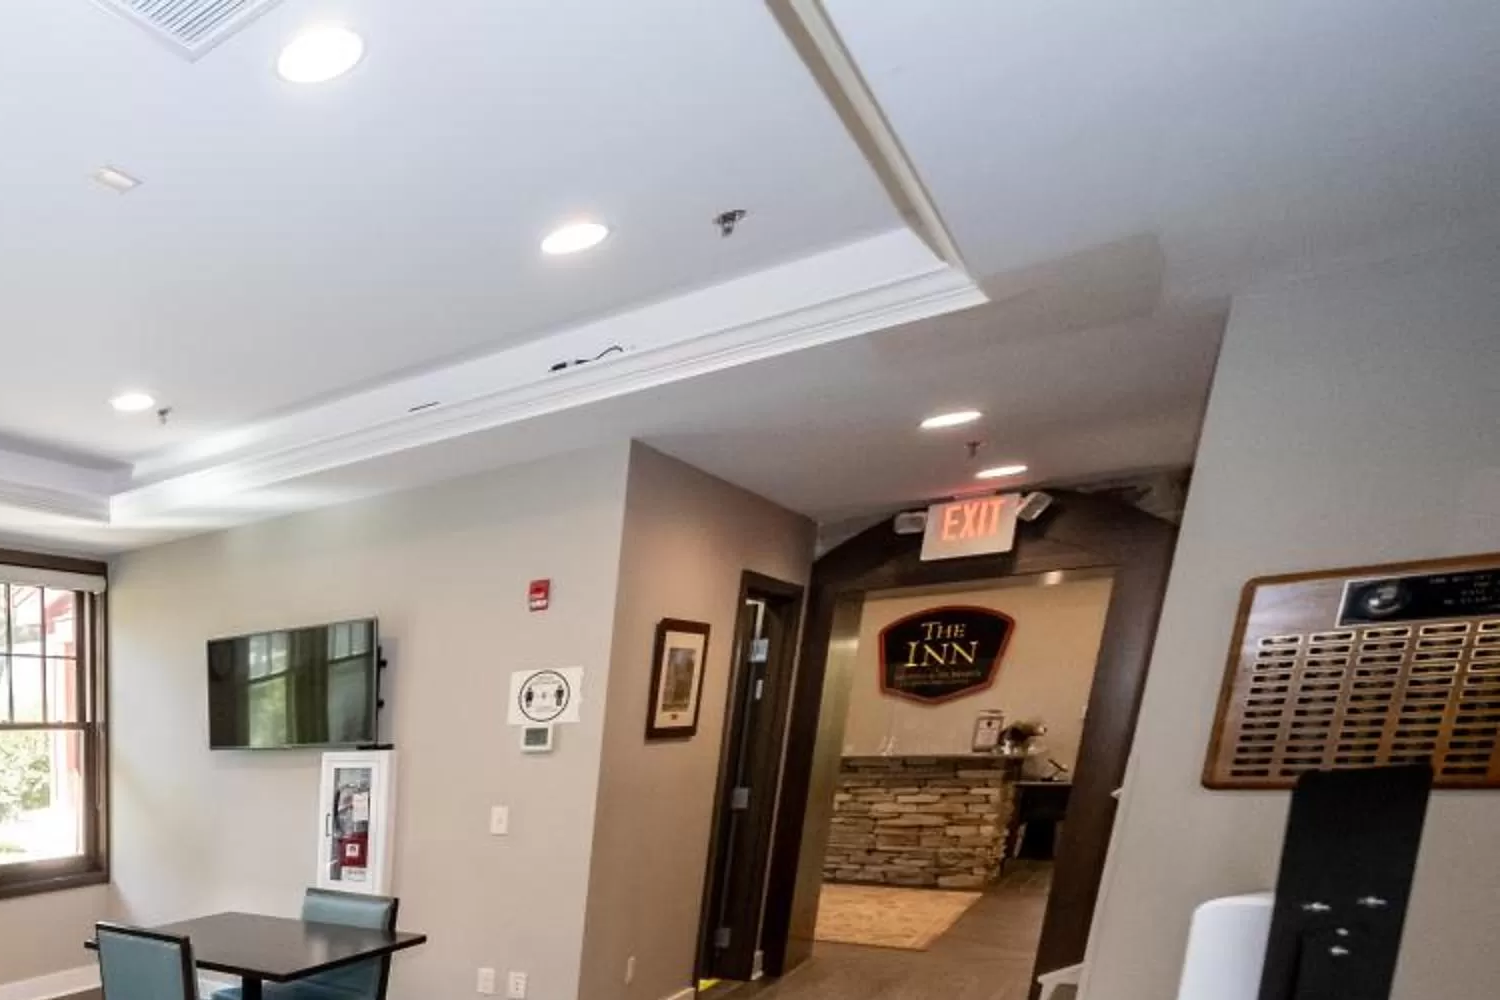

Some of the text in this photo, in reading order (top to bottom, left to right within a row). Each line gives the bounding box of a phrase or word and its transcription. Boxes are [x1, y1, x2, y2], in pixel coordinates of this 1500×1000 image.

[943, 501, 1001, 541] EXIT
[921, 621, 966, 641] THE
[904, 641, 978, 667] INN
